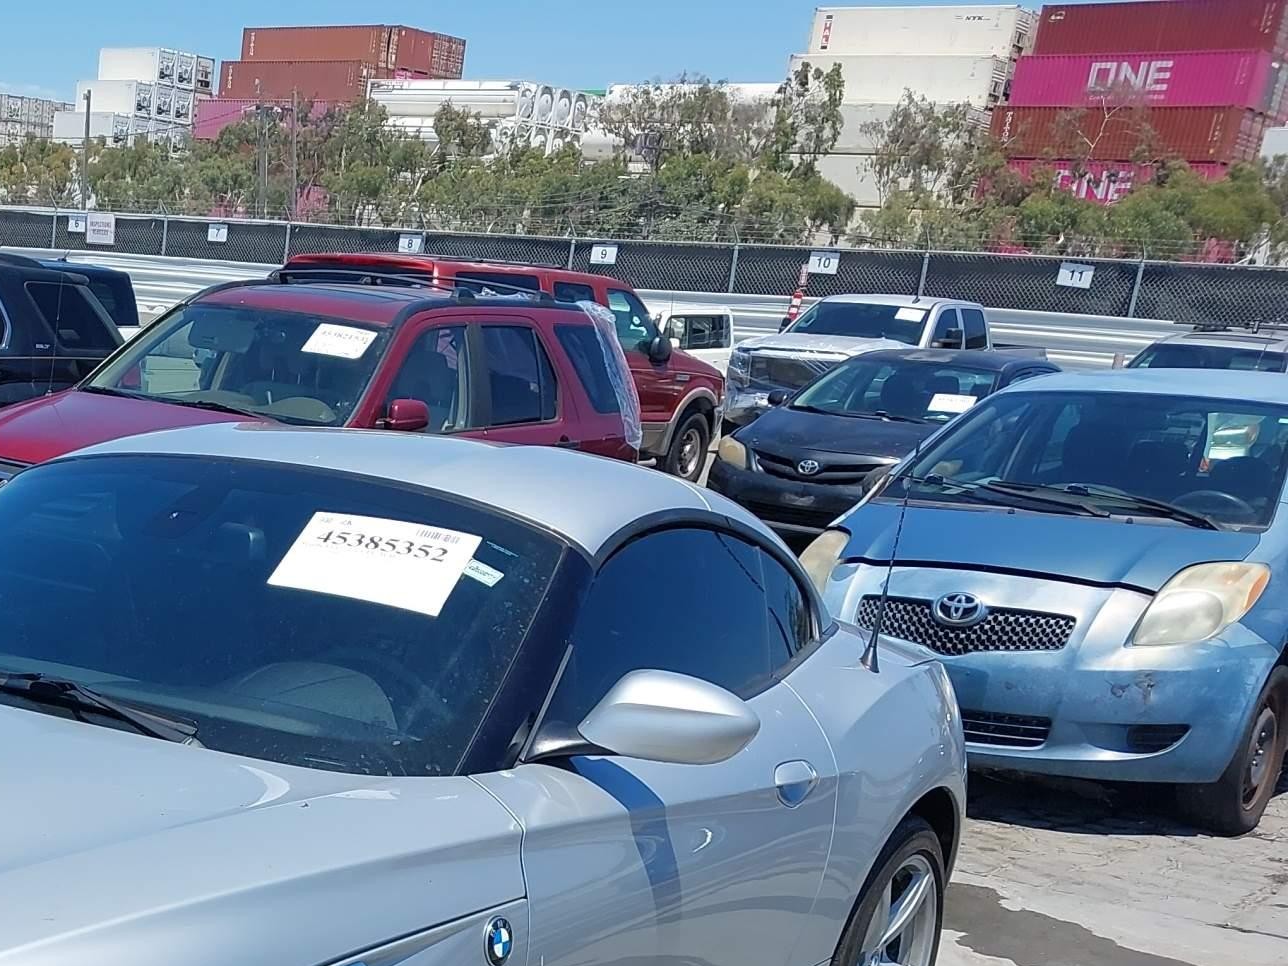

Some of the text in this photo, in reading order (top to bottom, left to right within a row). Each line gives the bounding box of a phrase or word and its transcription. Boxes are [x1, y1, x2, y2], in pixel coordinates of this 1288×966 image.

[1087, 60, 1174, 92] ONE
[74, 218, 80, 228] 6
[215, 228, 221, 237] 7
[407, 239, 414, 248] 8
[600, 249, 607, 259] 9
[816, 257, 831, 268] 10
[1070, 270, 1084, 281] 11
[316, 529, 449, 563] 45385352
